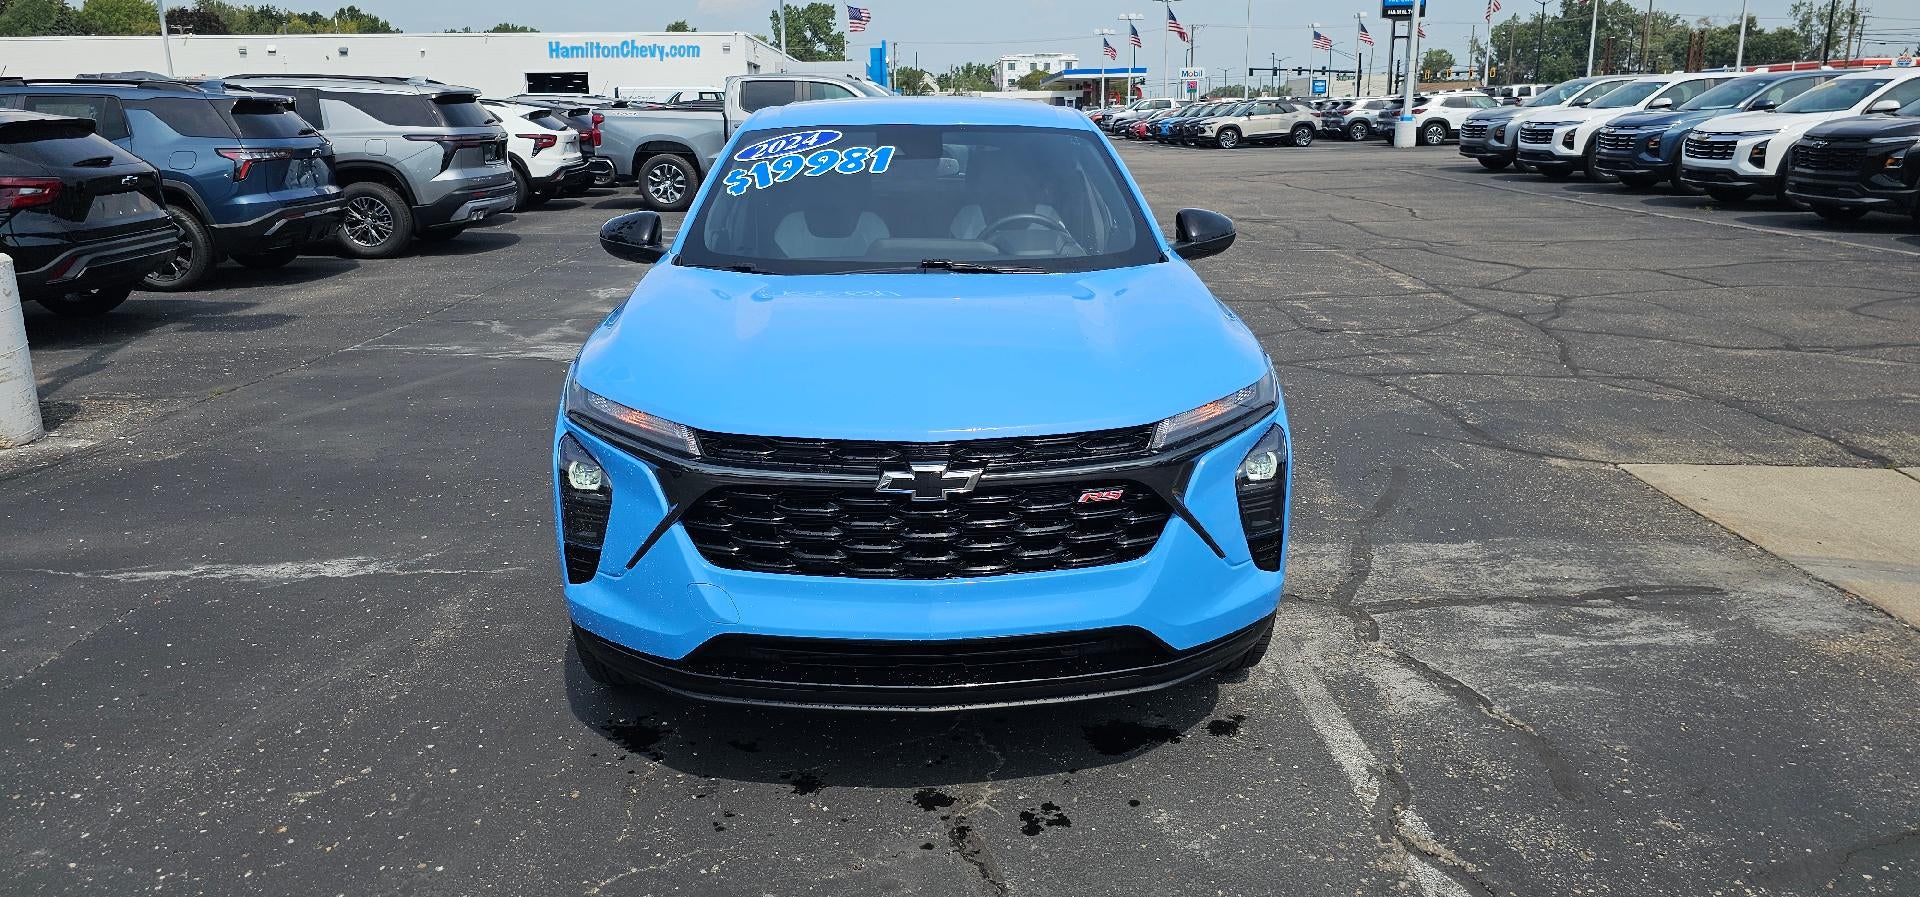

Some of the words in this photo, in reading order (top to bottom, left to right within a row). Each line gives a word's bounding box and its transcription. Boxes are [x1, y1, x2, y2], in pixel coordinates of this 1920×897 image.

[548, 40, 700, 62] HamiltonChevy.com
[1181, 70, 1203, 78] Mobil
[752, 131, 822, 156] 2024
[723, 146, 896, 196] $19981
[1078, 490, 1123, 502] RS
